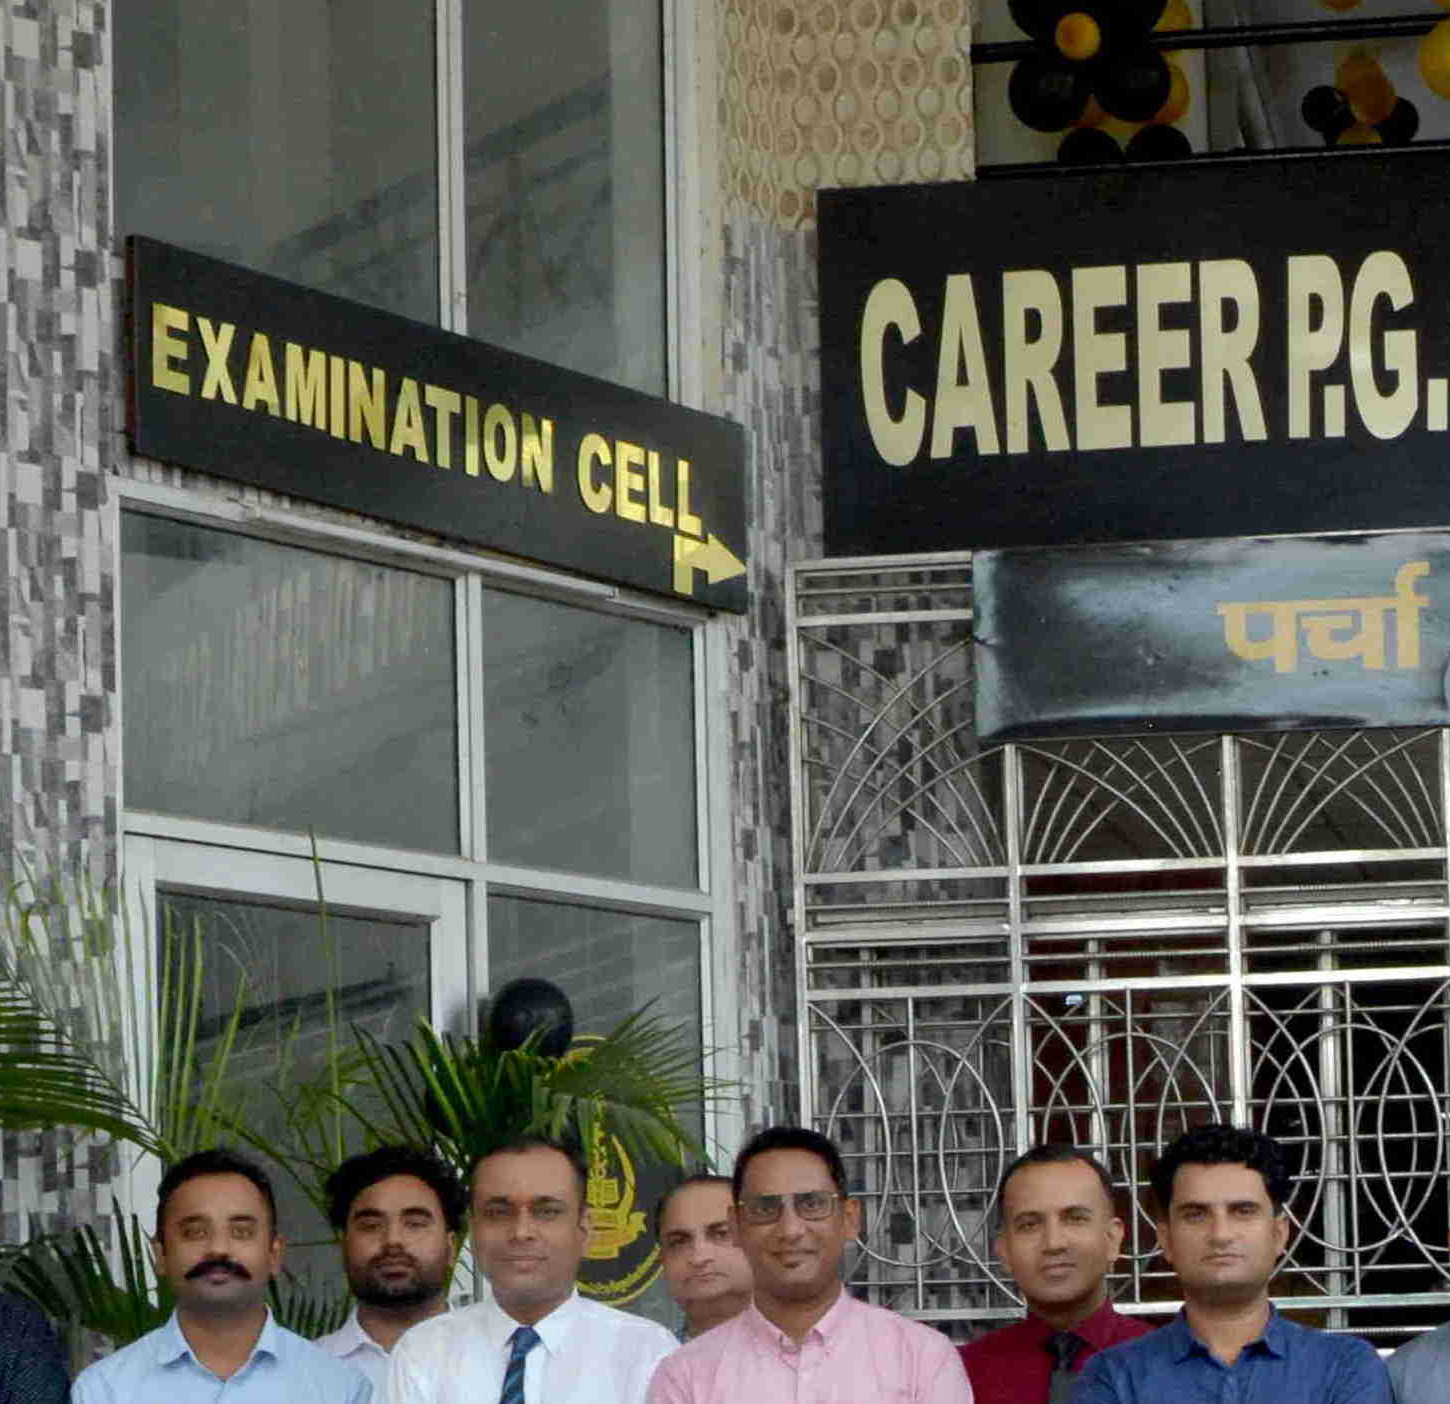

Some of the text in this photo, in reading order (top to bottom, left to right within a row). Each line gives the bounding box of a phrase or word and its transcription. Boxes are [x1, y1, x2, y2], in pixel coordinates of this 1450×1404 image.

[151, 302, 702, 537] EXAMINATION CELL
[860, 259, 1268, 467] CAREER
[1217, 561, 1431, 673] पर्चा
